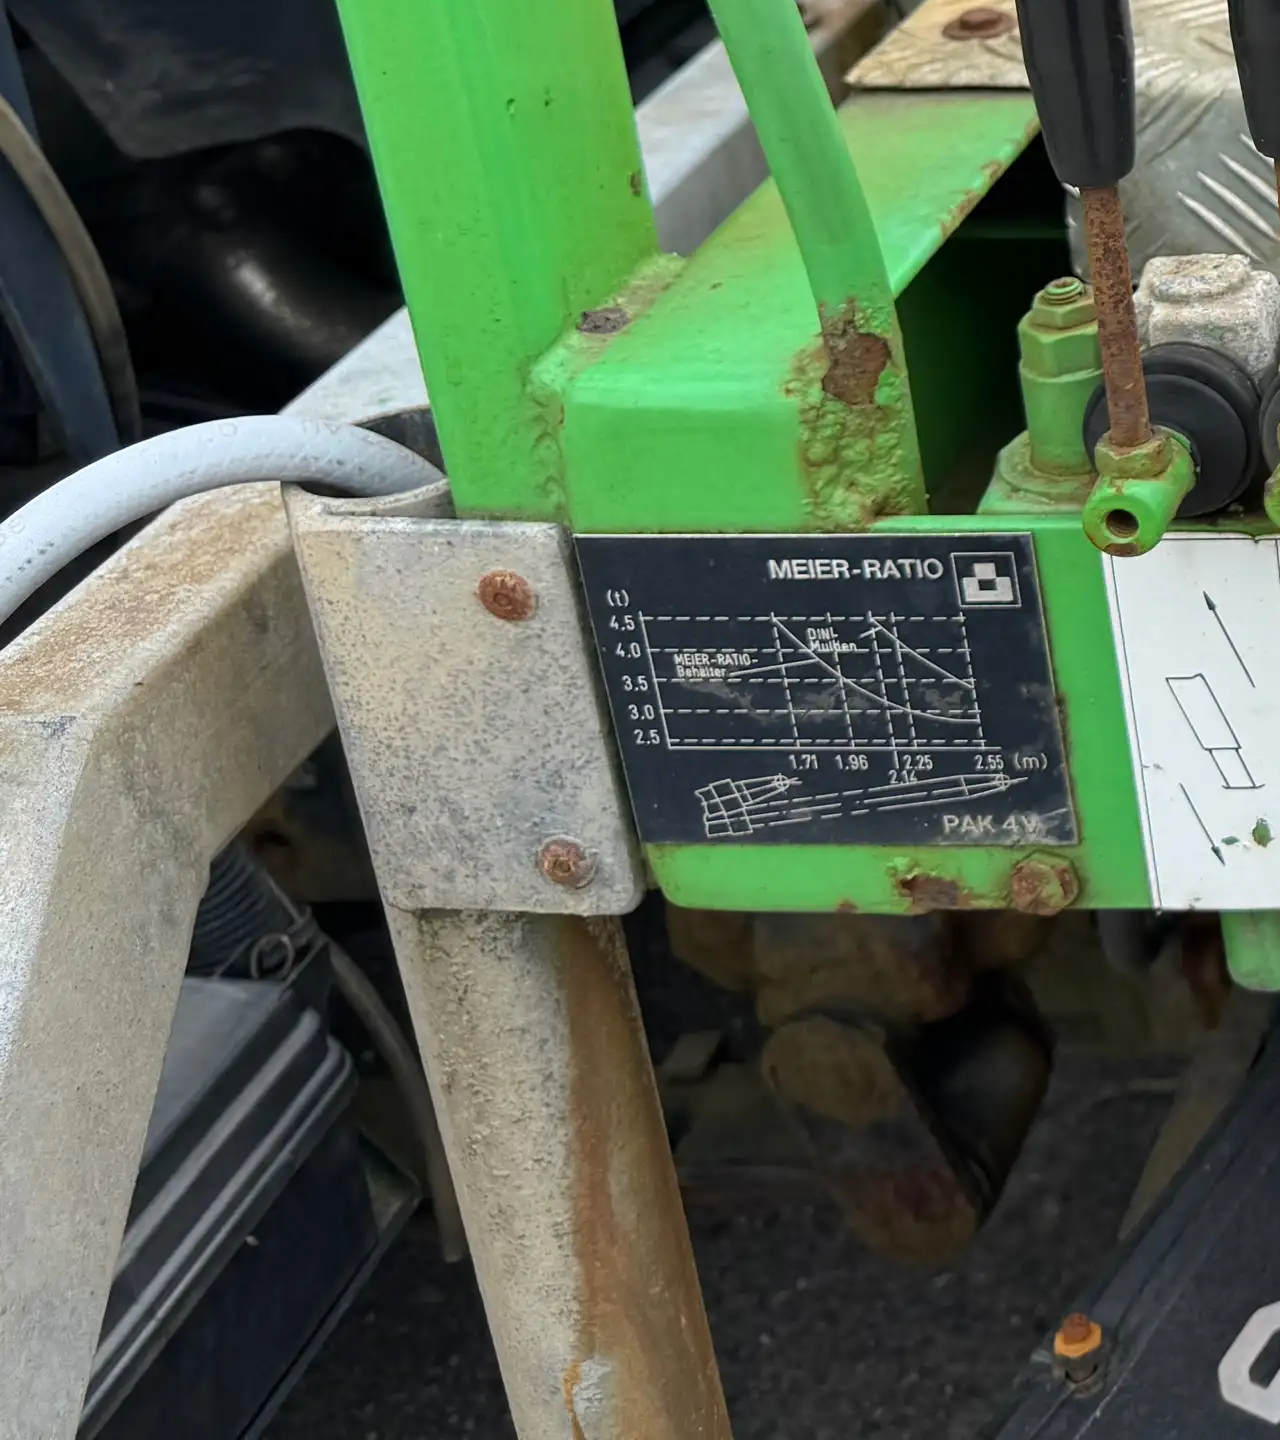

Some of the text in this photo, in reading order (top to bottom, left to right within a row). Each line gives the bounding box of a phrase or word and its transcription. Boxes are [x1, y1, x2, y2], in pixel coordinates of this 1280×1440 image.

[768, 558, 944, 580] MEIER-RATIO
[606, 589, 630, 608] (t)
[609, 614, 636, 632] 4.5
[615, 643, 642, 659] 4.0
[622, 675, 649, 691] 3.5
[628, 704, 655, 721] 3.0
[633, 729, 661, 745] 2.5
[788, 752, 1048, 770] 1.71 1.96 2.25 2.55 (m)
[943, 814, 996, 833] PAK
